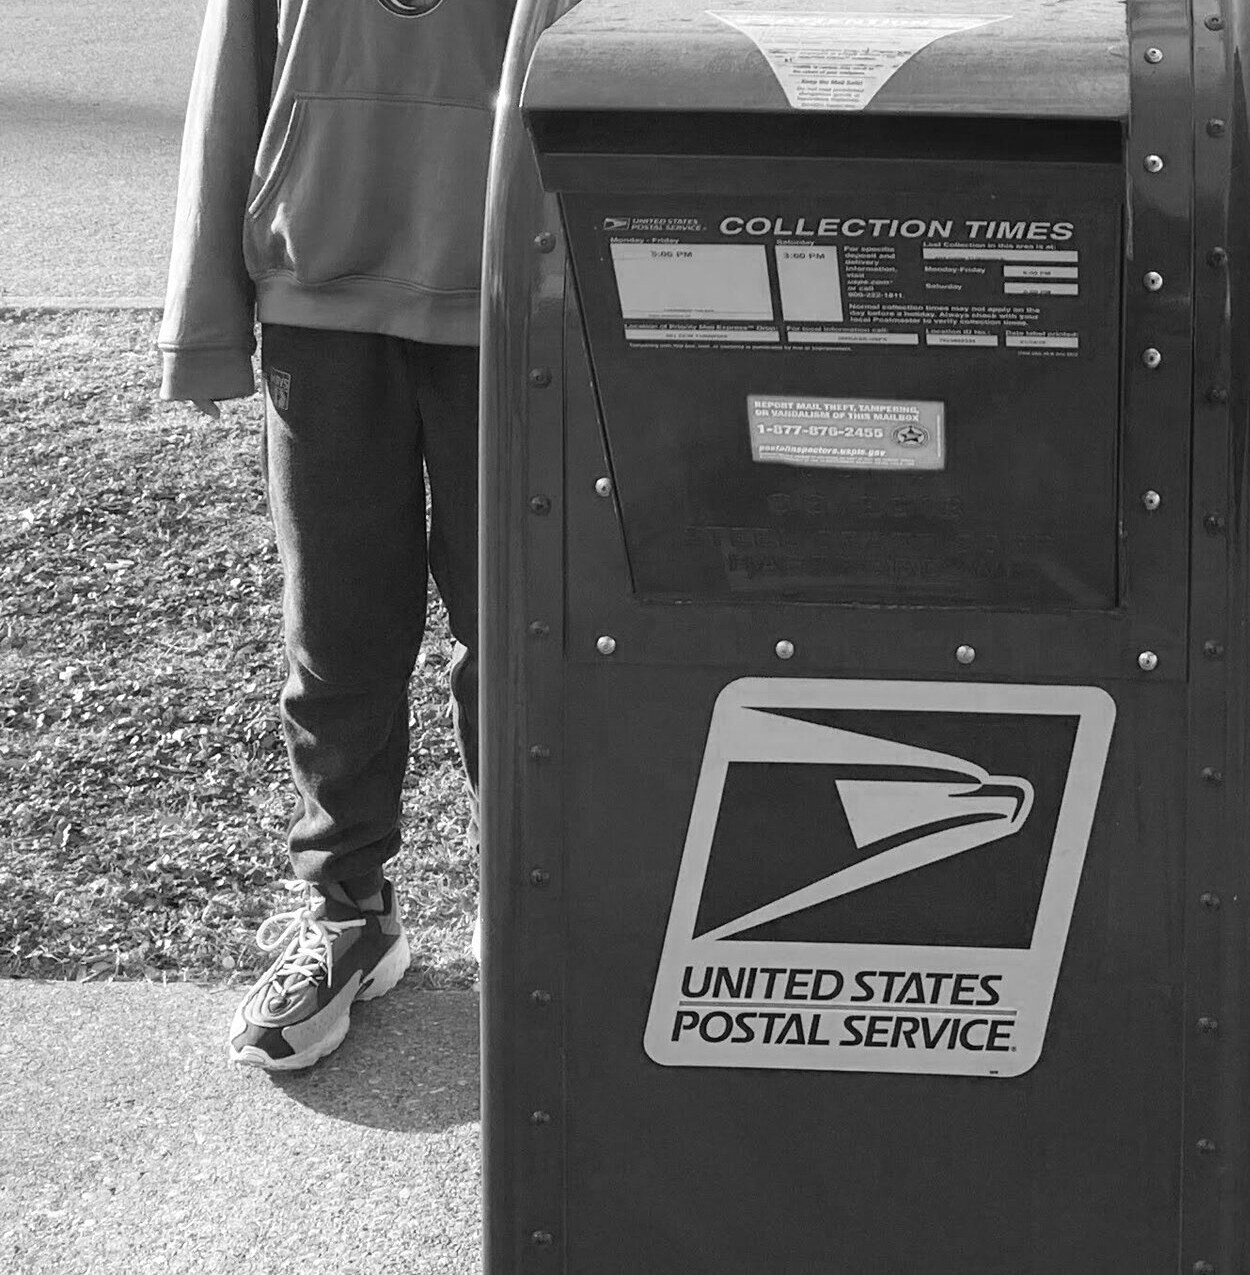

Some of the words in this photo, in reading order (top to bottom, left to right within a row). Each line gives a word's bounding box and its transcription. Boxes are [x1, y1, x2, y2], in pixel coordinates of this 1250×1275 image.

[720, 217, 954, 239] COLLECTION
[965, 220, 1075, 241] TIMES
[754, 401, 793, 410] REPORT
[796, 402, 822, 411] MAIL
[755, 409, 769, 417] OR
[771, 410, 830, 419] VANDALISM
[848, 412, 872, 420] THIS
[873, 413, 920, 422] MAILBOX
[757, 423, 885, 439] 1-877-876-2455
[681, 966, 845, 1002] UNITED
[851, 971, 1004, 1007] STATES
[671, 1009, 830, 1047] POSTAL
